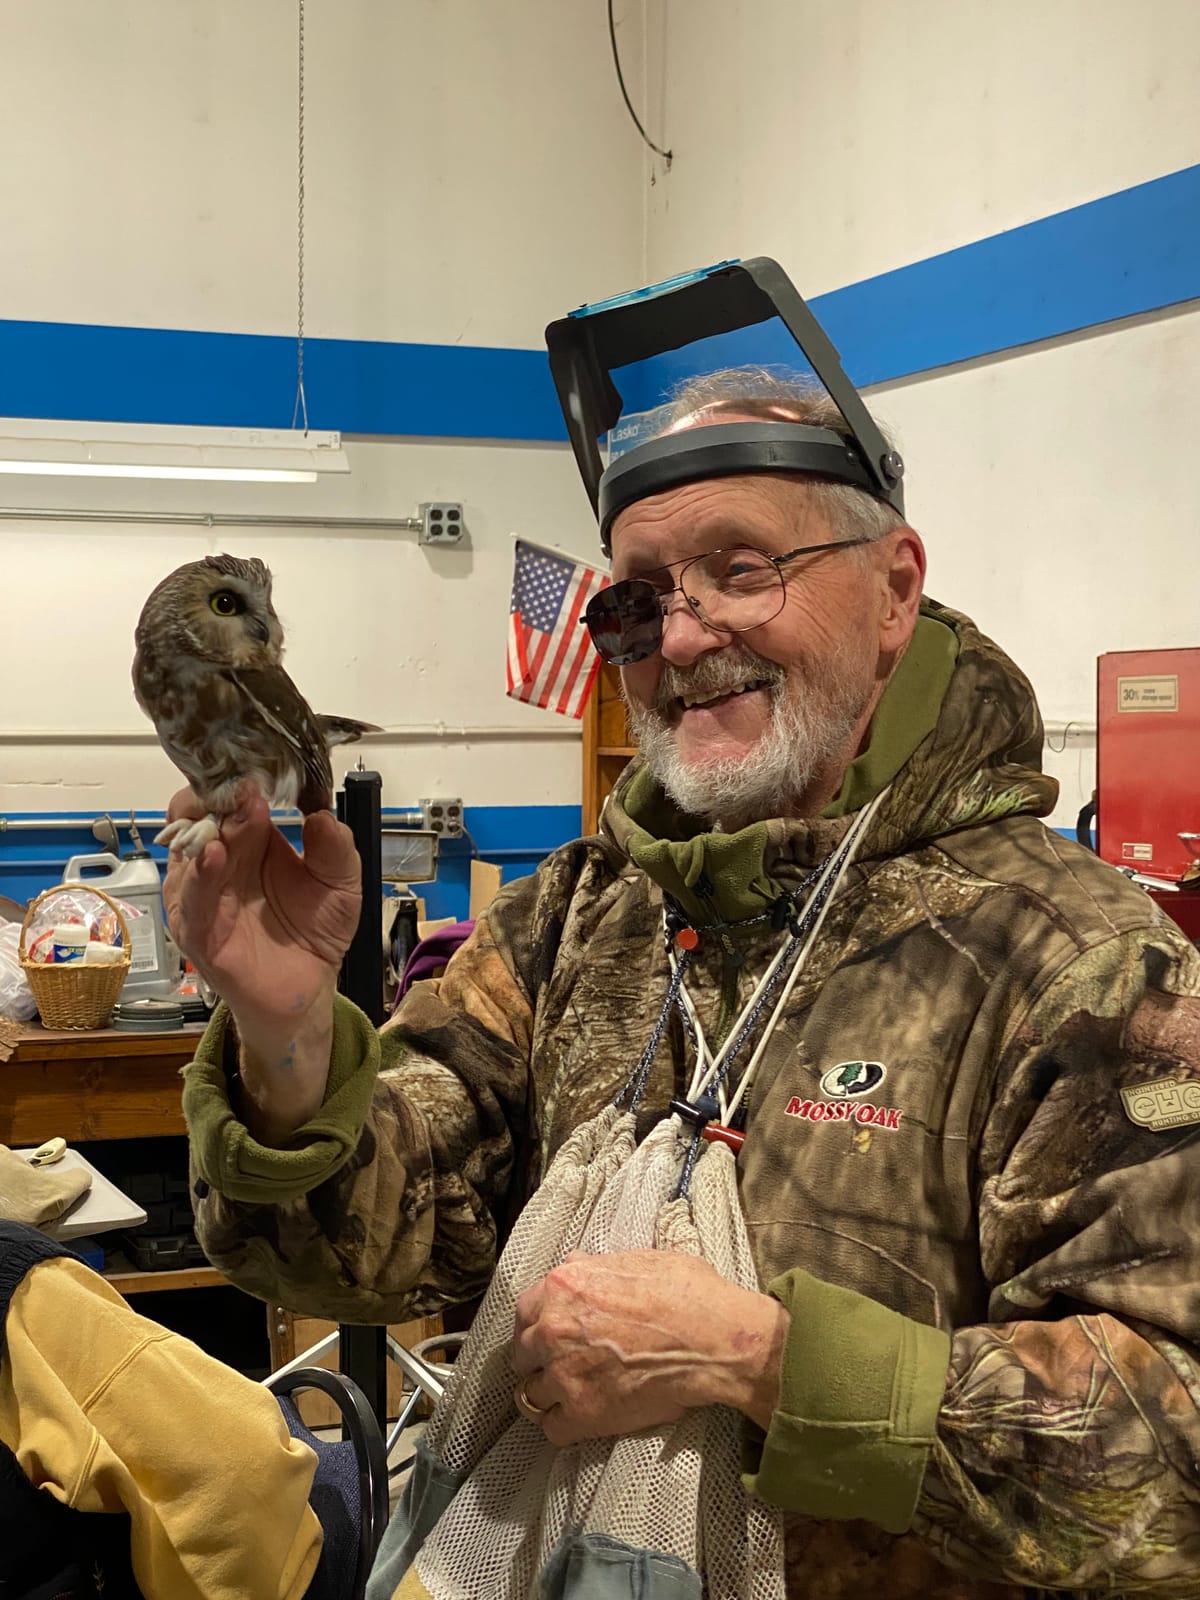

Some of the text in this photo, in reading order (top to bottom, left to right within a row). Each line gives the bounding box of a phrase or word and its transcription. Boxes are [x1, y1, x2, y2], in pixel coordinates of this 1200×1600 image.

[611, 424, 639, 442] Lasko
[784, 1096, 903, 1131] MOSSY OAK
